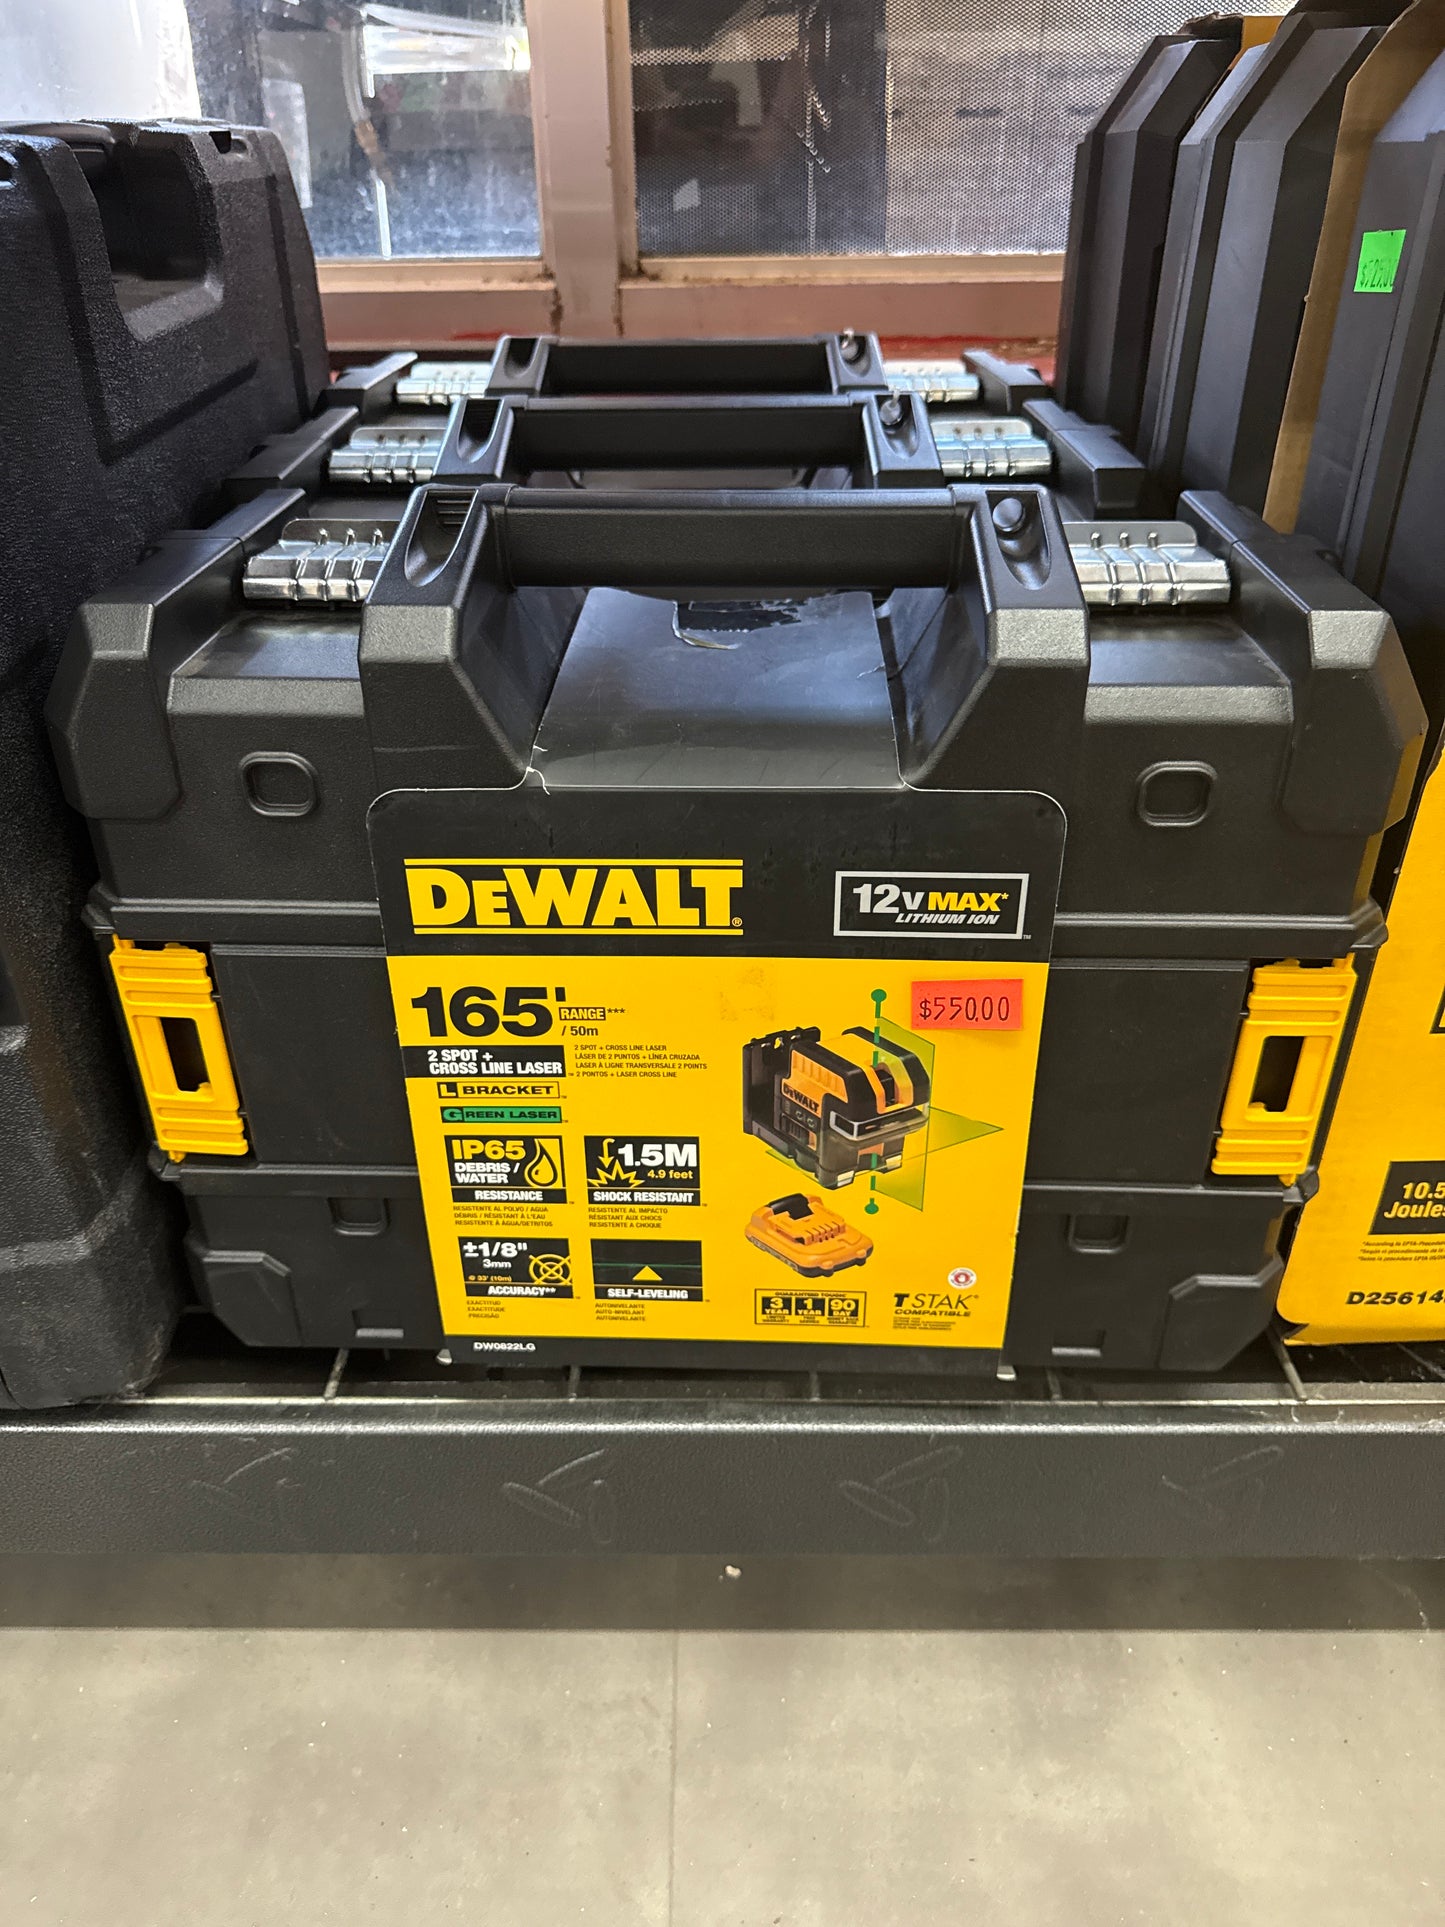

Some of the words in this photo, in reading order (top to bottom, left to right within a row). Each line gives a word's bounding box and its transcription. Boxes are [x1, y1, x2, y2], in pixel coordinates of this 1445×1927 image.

[895, 913, 967, 924] LITHIUM
[967, 914, 1000, 925] ION
[411, 986, 566, 1037] 165'
[919, 996, 1009, 1022] $550.00
[570, 1026, 598, 1036] 50m
[428, 1050, 438, 1061] 2
[442, 1050, 478, 1061] SPOT
[483, 1052, 493, 1061] +
[429, 1062, 478, 1074] CROSS
[481, 1062, 513, 1074] LINE
[517, 1062, 563, 1074] LASER
[463, 1086, 554, 1094] BRACKET
[443, 1109, 504, 1120] GREEN
[452, 1140, 526, 1160] IP65
[618, 1143, 697, 1167] 1.5M
[454, 1162, 511, 1172] DEBRIS
[455, 1173, 509, 1184] WATER
[647, 1169, 666, 1179] 4.9
[669, 1170, 693, 1179] feet
[475, 1190, 543, 1201] RESISTANCE
[1403, 1182, 1445, 1199] 10.5
[593, 1191, 631, 1201] SHOCK
[634, 1192, 694, 1203] RESISTANT
[1384, 1202, 1445, 1218] Joule
[483, 1259, 511, 1268] 3mm
[608, 1288, 688, 1299] SELF-LEVELING
[770, 1298, 783, 1308] 3
[804, 1299, 813, 1309] 1
[830, 1300, 855, 1310] 90
[894, 1309, 971, 1317] COMPATIBLE
